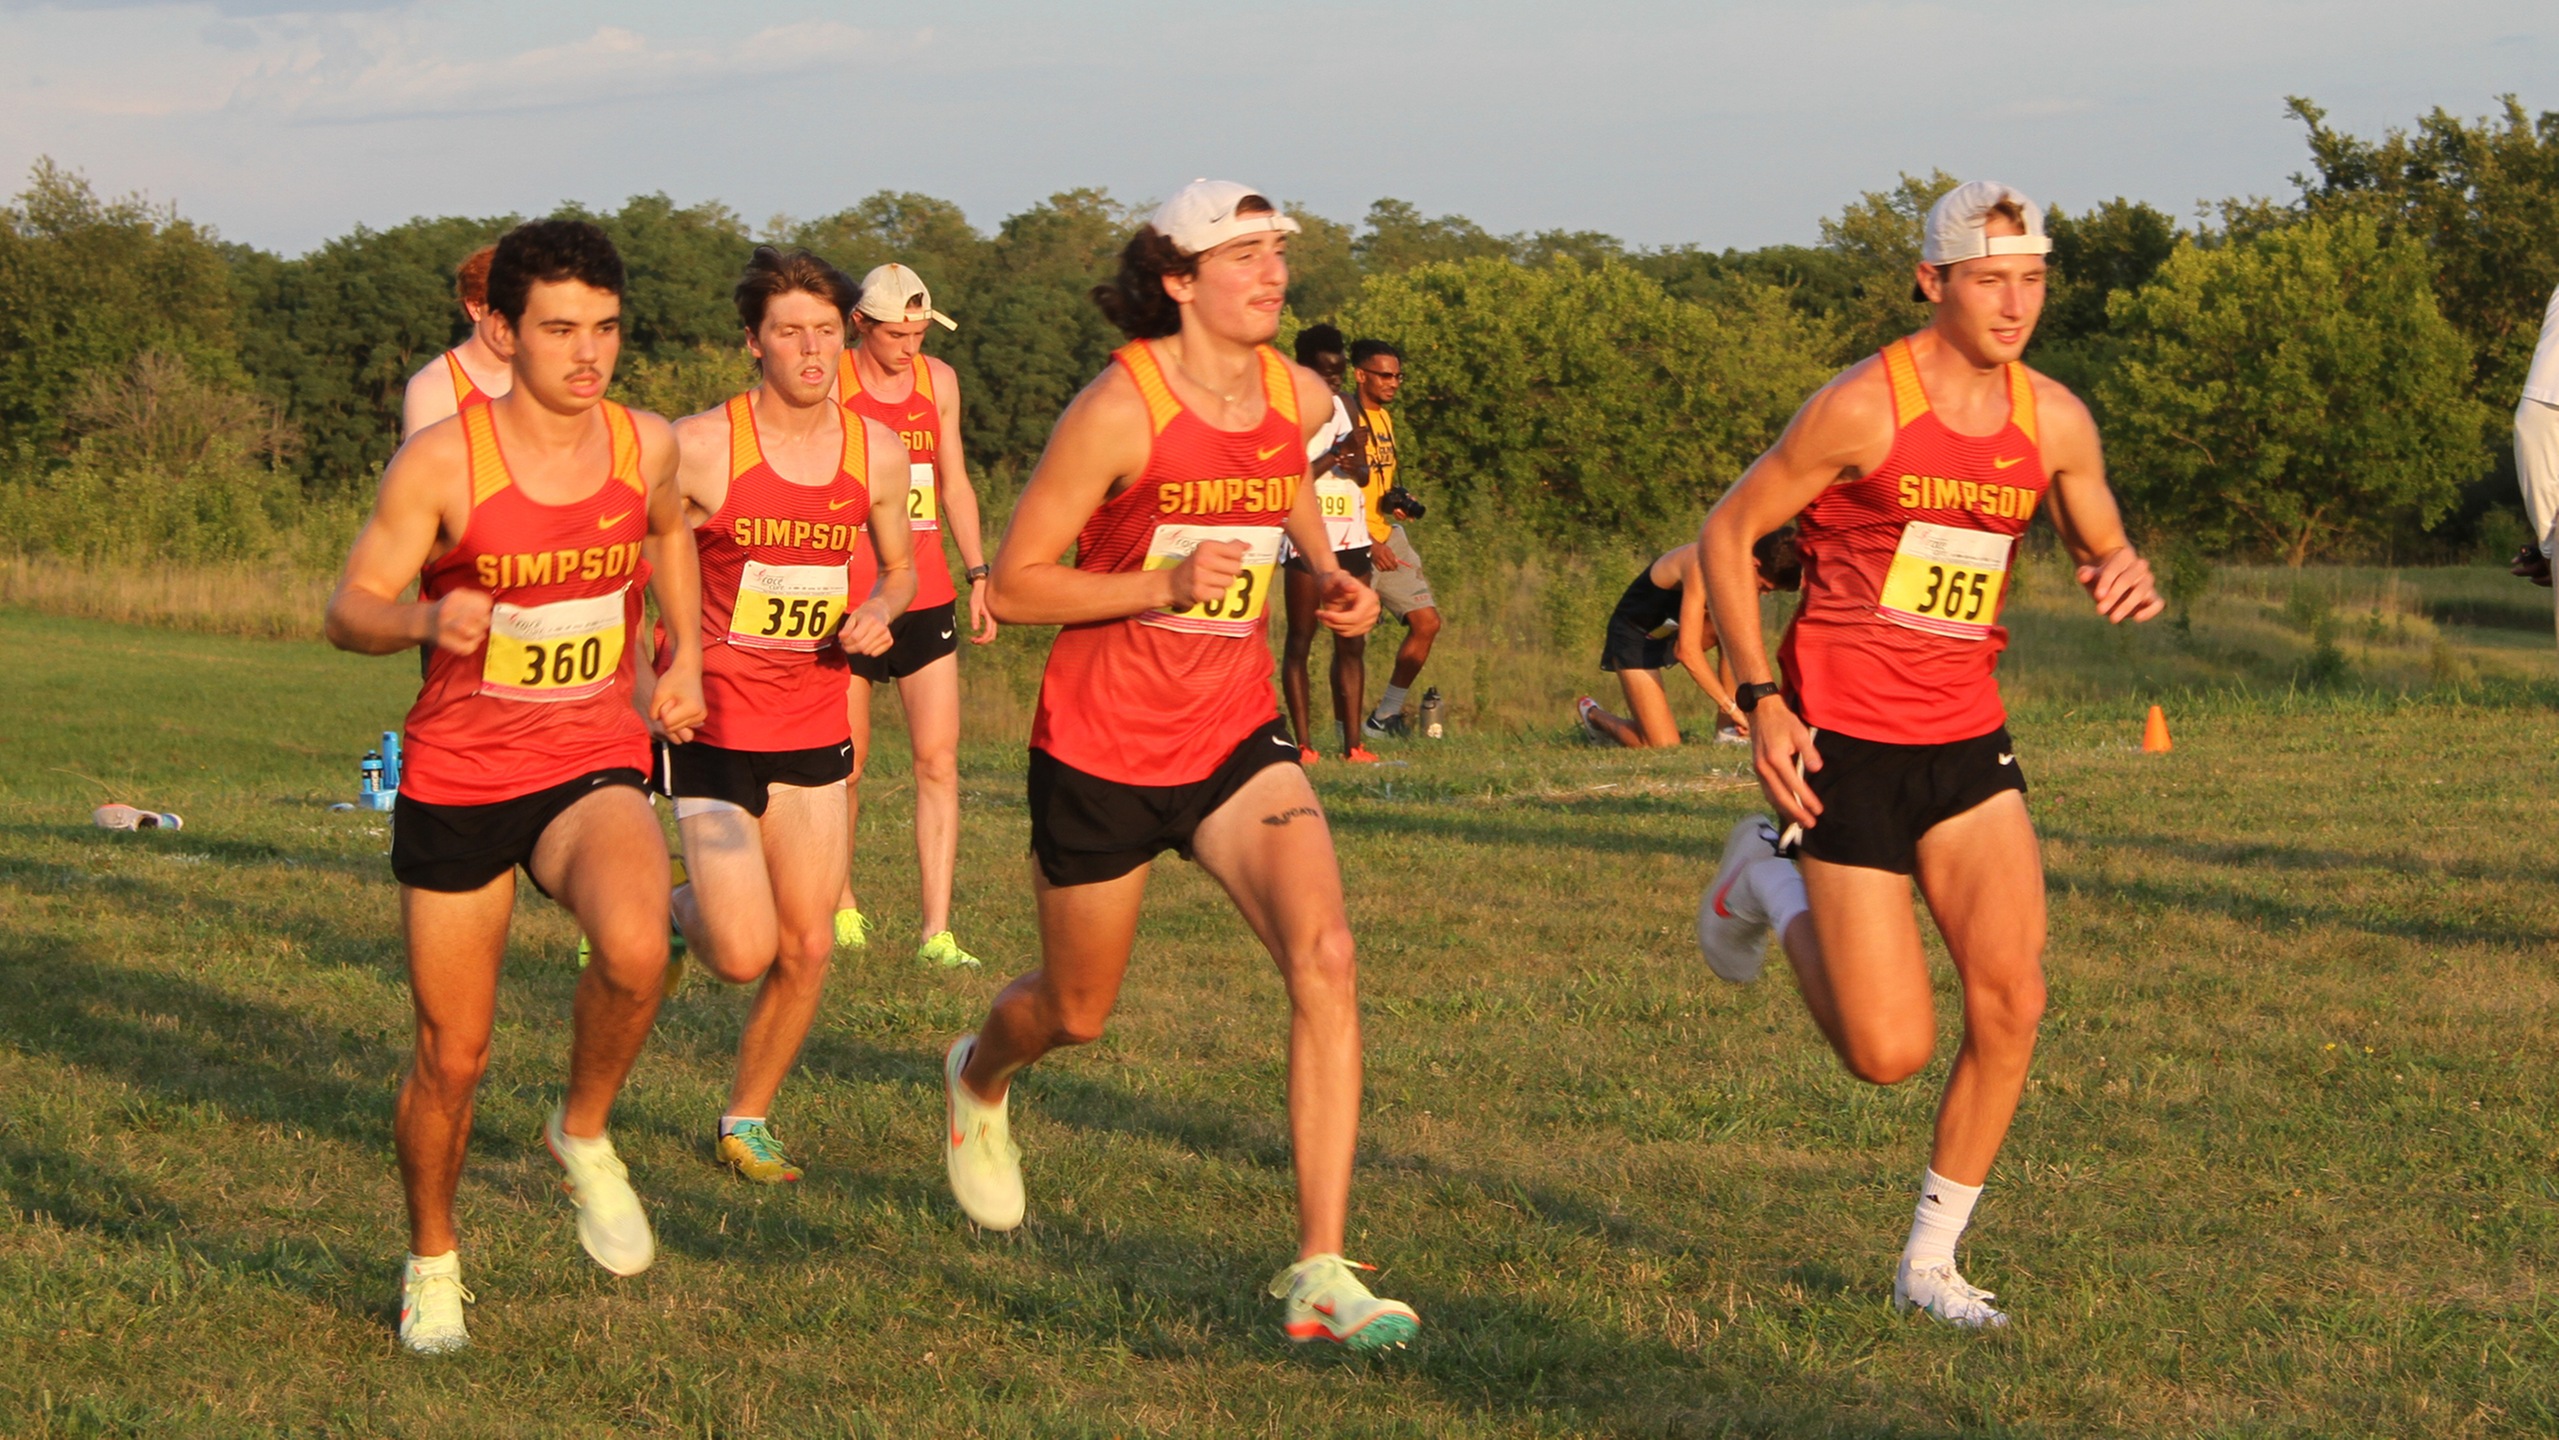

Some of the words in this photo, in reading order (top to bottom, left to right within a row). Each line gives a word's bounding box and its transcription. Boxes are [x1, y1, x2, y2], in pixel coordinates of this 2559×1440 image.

[1898, 475, 2037, 520] SIMPSON
[1916, 565, 1990, 621] 365
[761, 598, 829, 637] 356
[519, 637, 601, 685] 360
